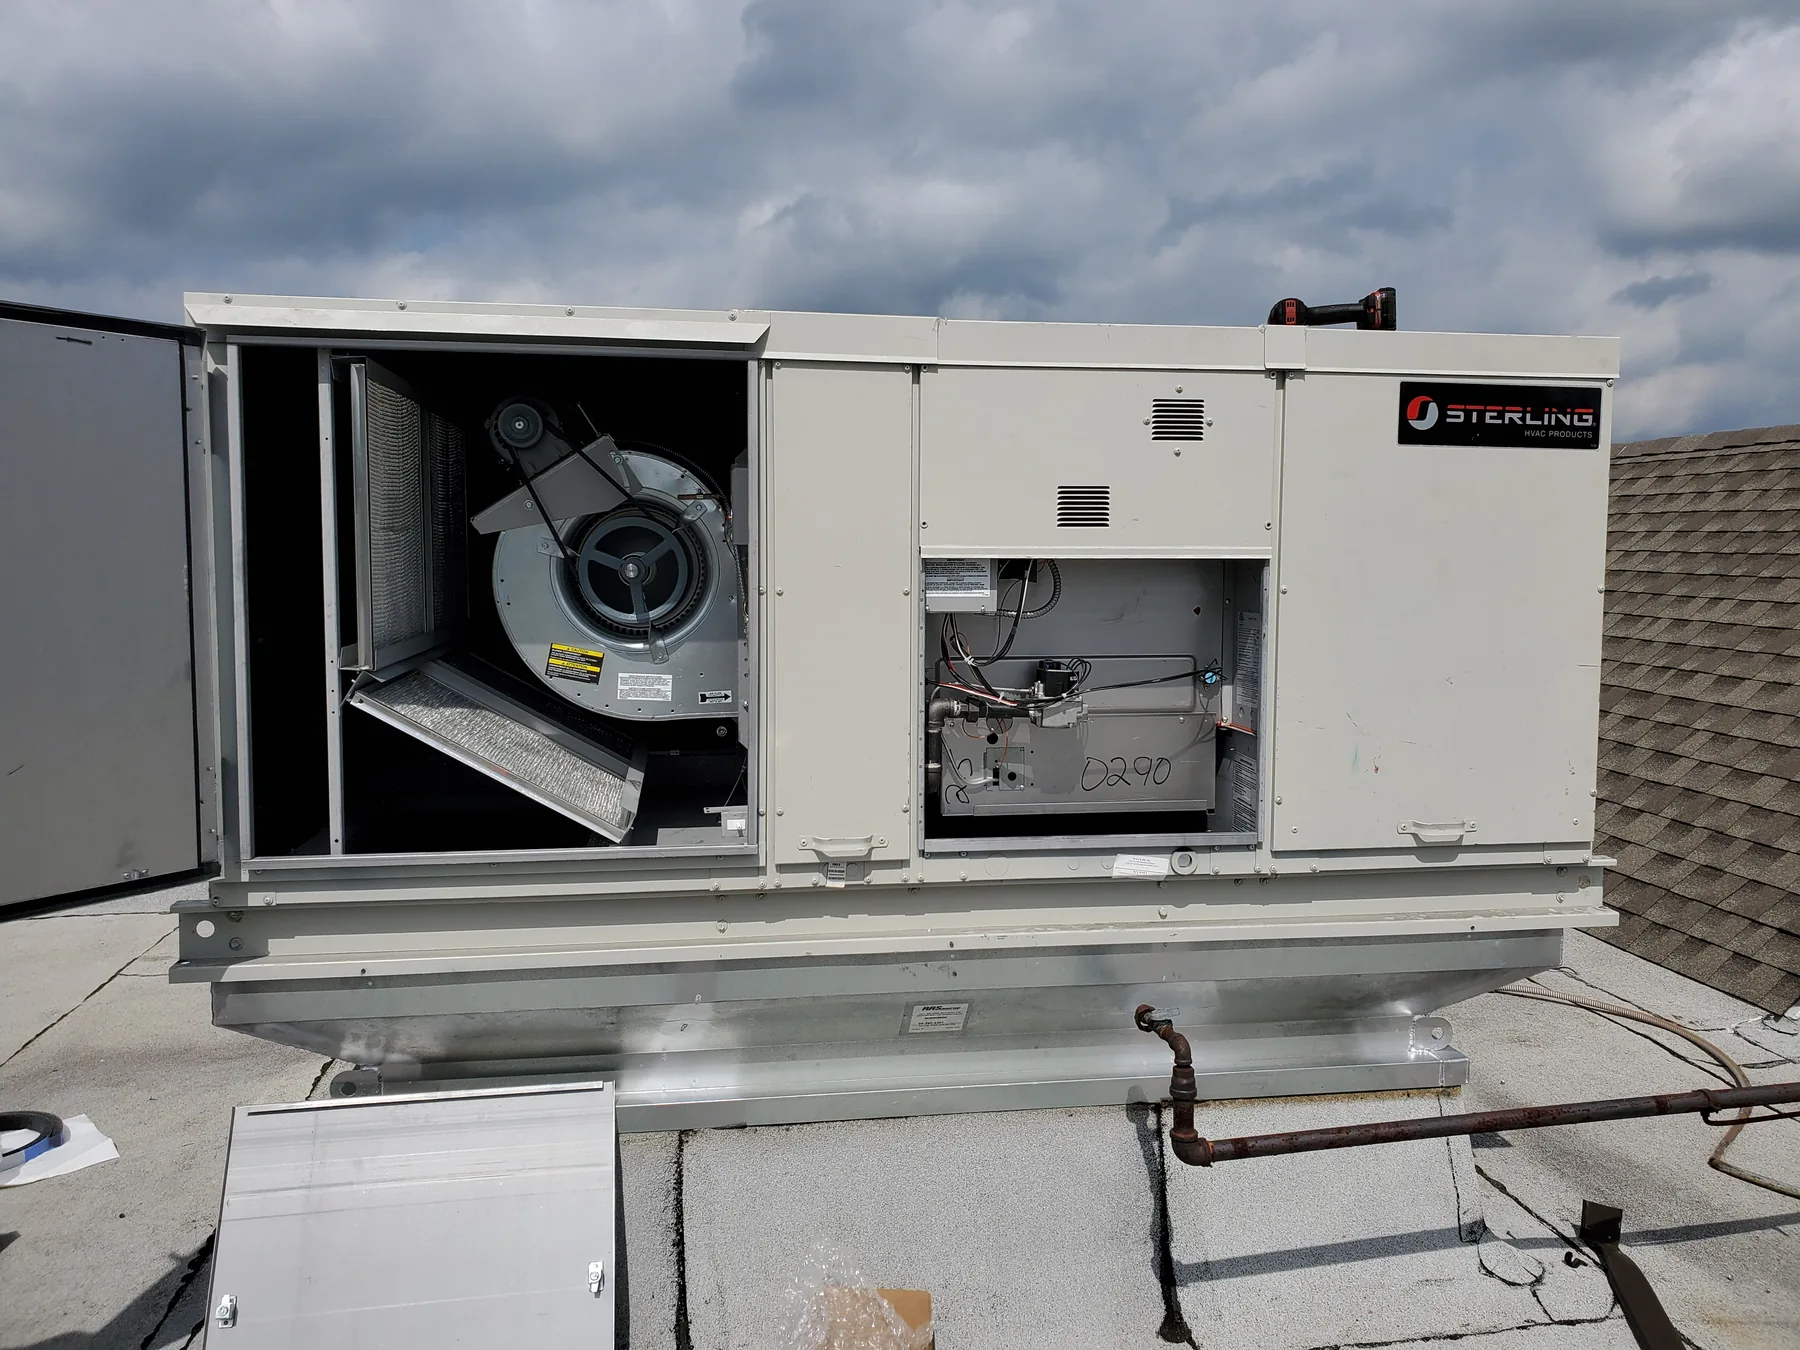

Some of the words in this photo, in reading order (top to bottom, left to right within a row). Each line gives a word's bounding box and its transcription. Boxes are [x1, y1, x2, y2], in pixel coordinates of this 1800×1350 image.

[1446, 404, 1594, 427] STERLING
[1524, 429, 1546, 438] HVAC
[1549, 430, 1593, 439] PRODUCTS
